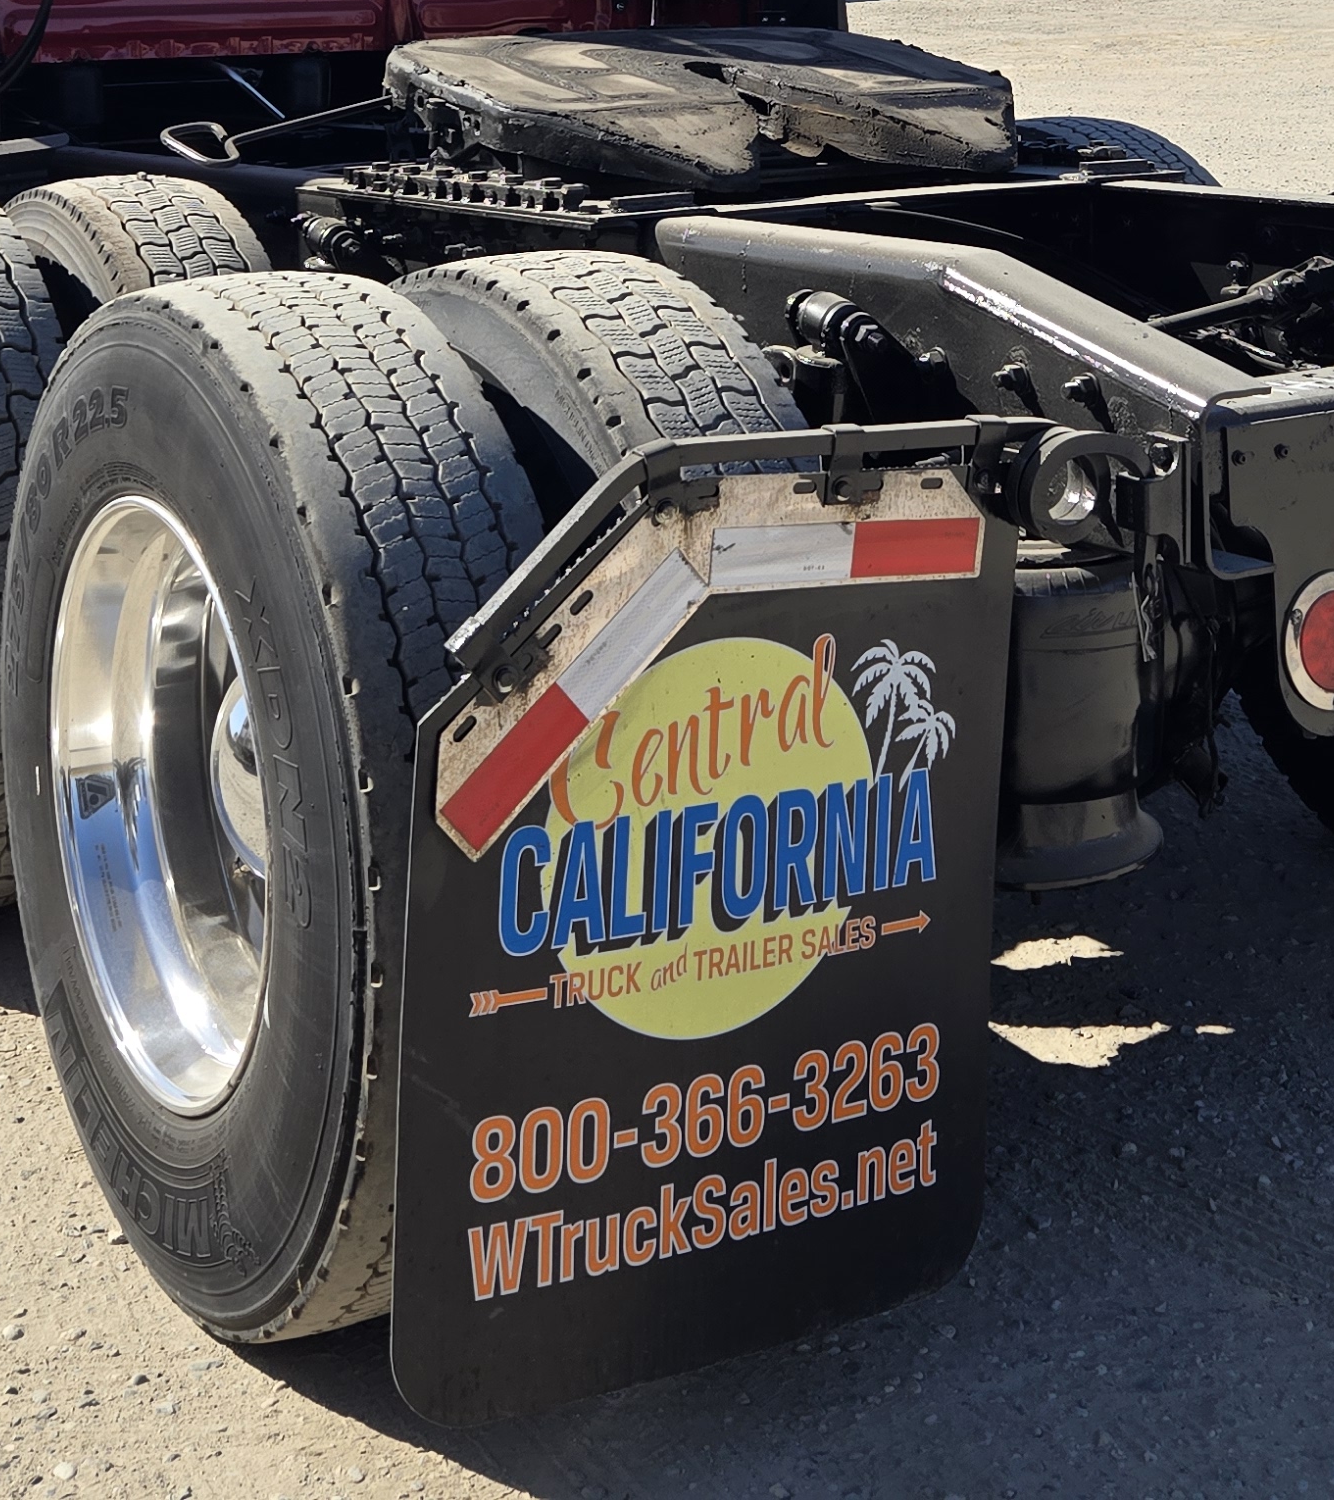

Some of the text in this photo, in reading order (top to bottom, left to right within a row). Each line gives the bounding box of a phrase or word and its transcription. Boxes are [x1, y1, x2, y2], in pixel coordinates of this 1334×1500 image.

[549, 632, 836, 830] Central
[499, 768, 936, 957] CALIFORNIA
[549, 915, 877, 1009] TRUCK and TRAILER SALES
[49, 1016, 214, 1259] MICHELIN
[469, 1022, 941, 1203] 800-366-3263
[467, 1119, 938, 1301] WTruckSales.net
